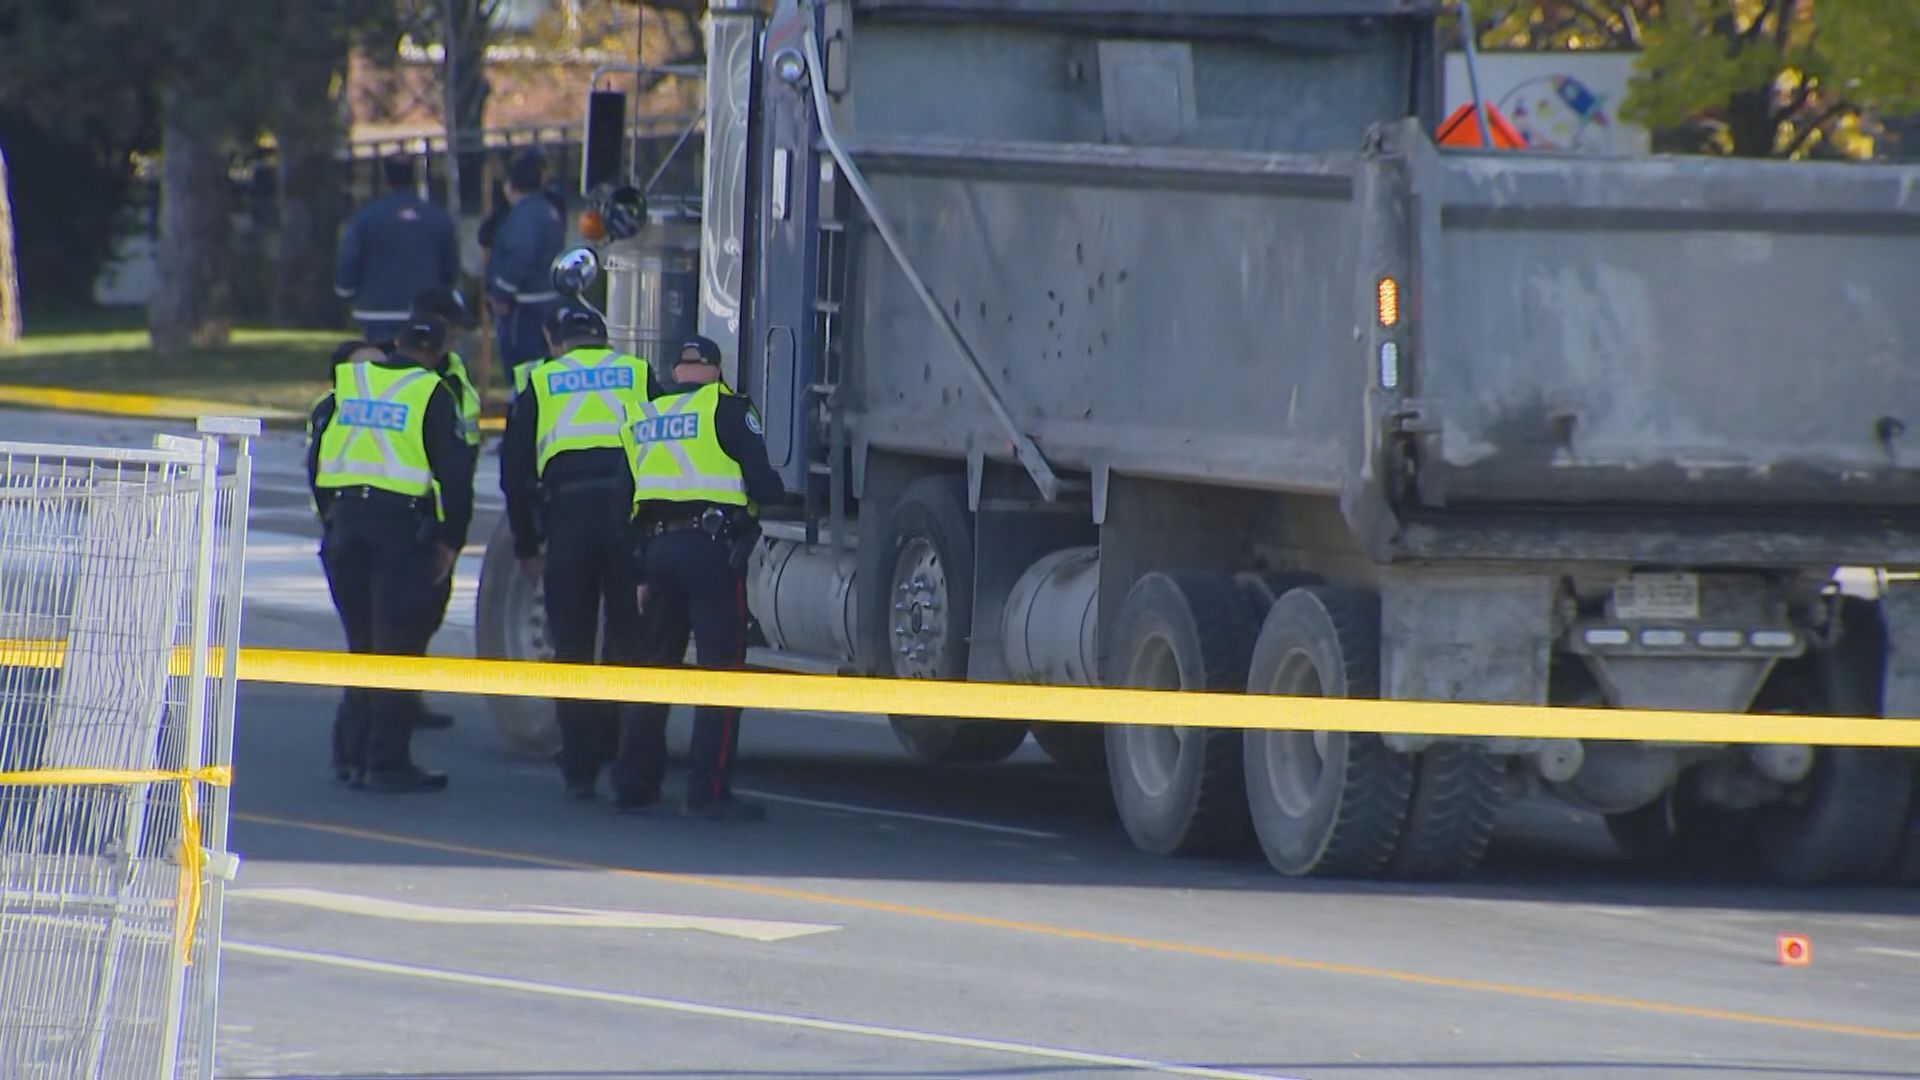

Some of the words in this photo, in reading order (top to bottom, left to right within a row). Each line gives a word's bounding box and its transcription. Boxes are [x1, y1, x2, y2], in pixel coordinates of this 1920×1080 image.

[549, 367, 631, 393] POLICE
[340, 401, 406, 429] POLICE
[634, 415, 697, 442] OLICE
